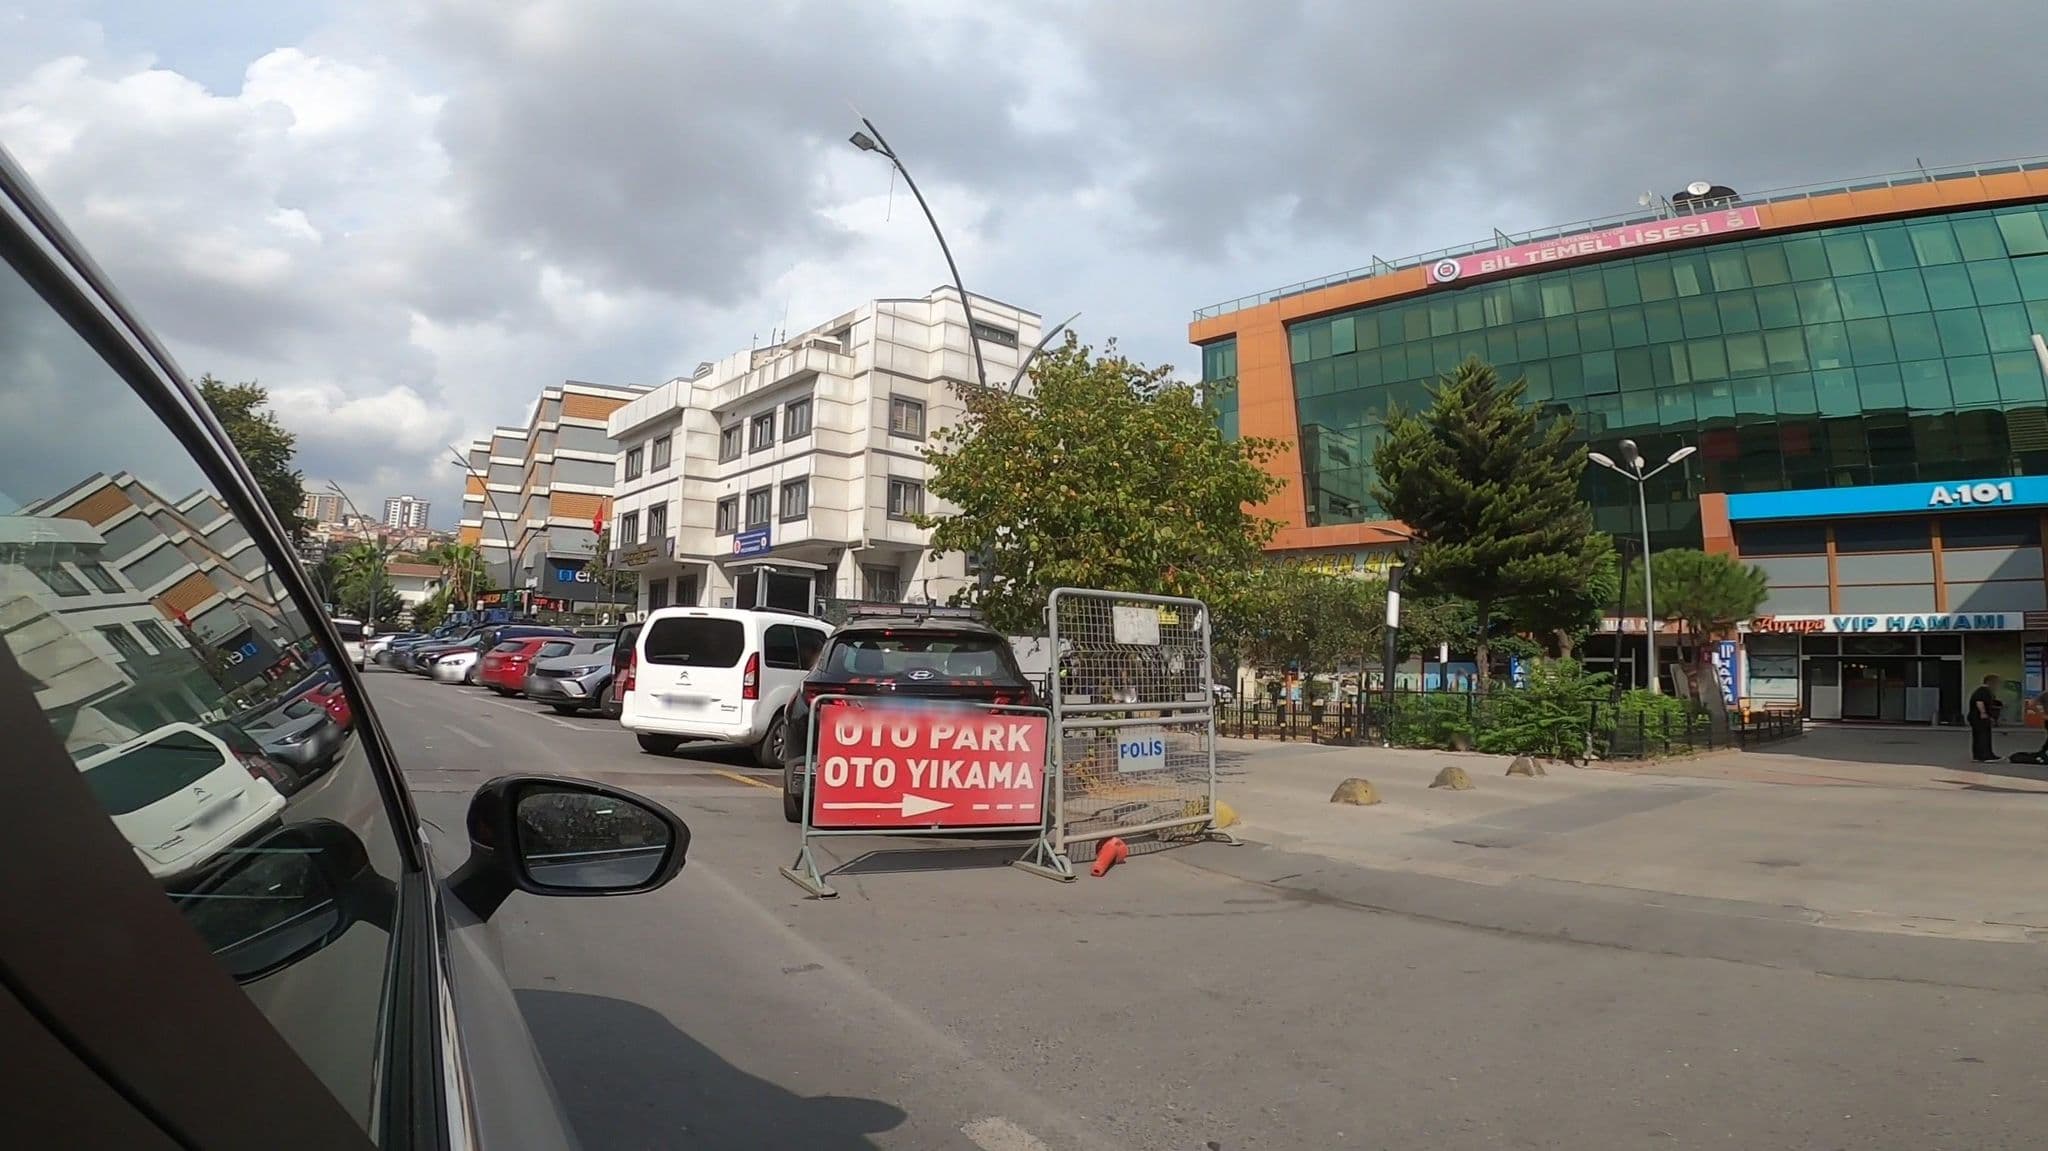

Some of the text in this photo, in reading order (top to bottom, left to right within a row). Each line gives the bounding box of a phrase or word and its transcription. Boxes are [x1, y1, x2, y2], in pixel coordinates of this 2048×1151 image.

[1480, 255, 1518, 273] BİL
[1525, 235, 1613, 263] TEMEL
[1619, 219, 1709, 247] LİSESİ
[1833, 616, 1877, 631] VIP
[1886, 614, 2005, 631] HAMAMI
[834, 716, 1033, 752] OTO PARK
[1120, 737, 1163, 759] POLİS
[823, 756, 1034, 789] OTO YIKAMA
